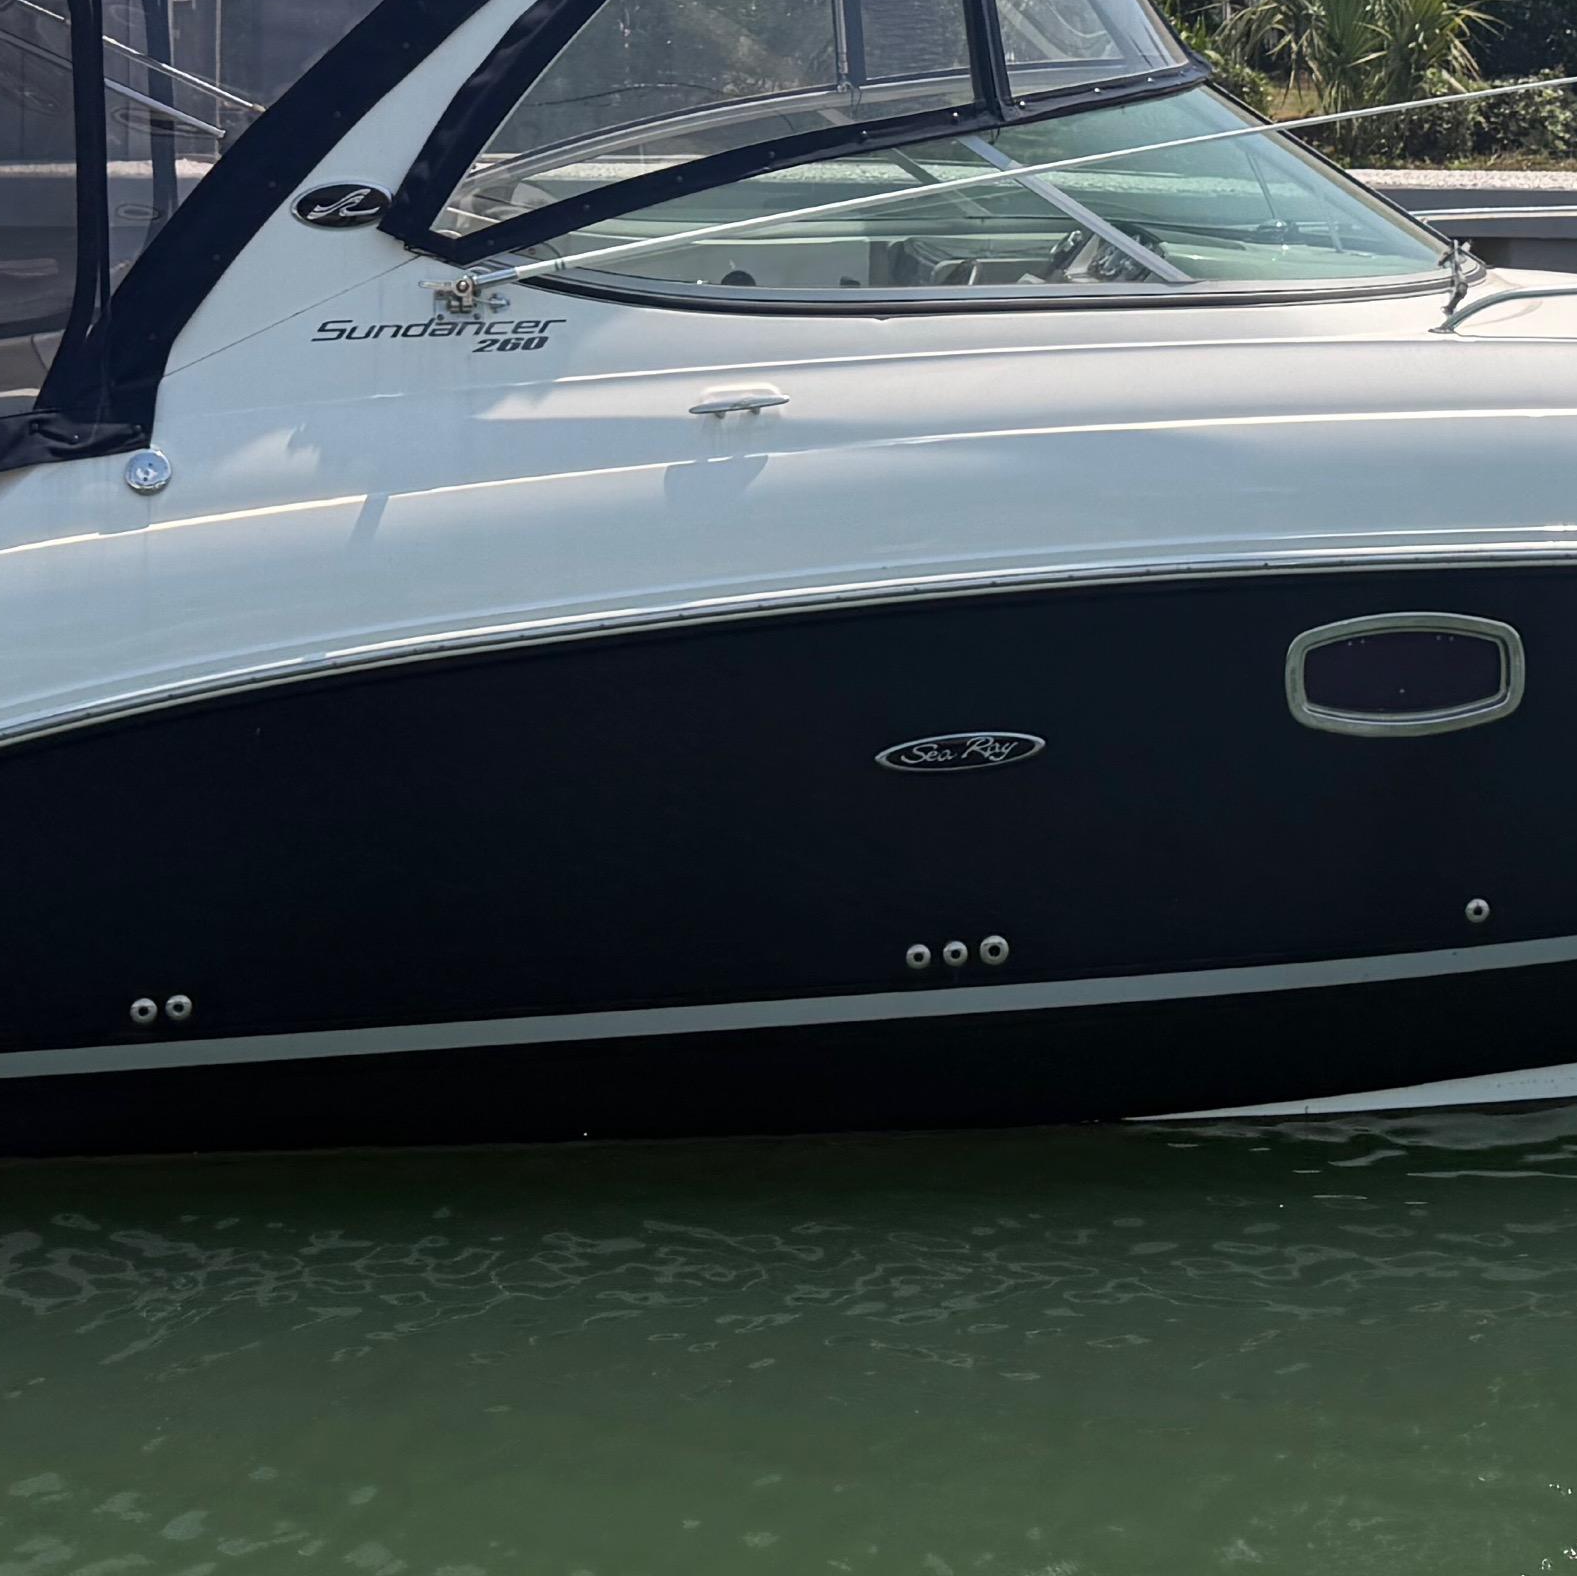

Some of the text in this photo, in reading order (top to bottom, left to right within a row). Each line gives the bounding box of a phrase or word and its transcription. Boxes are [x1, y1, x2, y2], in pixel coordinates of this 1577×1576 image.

[311, 318, 567, 341] Sundancer
[472, 336, 549, 353] 260
[900, 736, 1018, 764] Sea Ray
